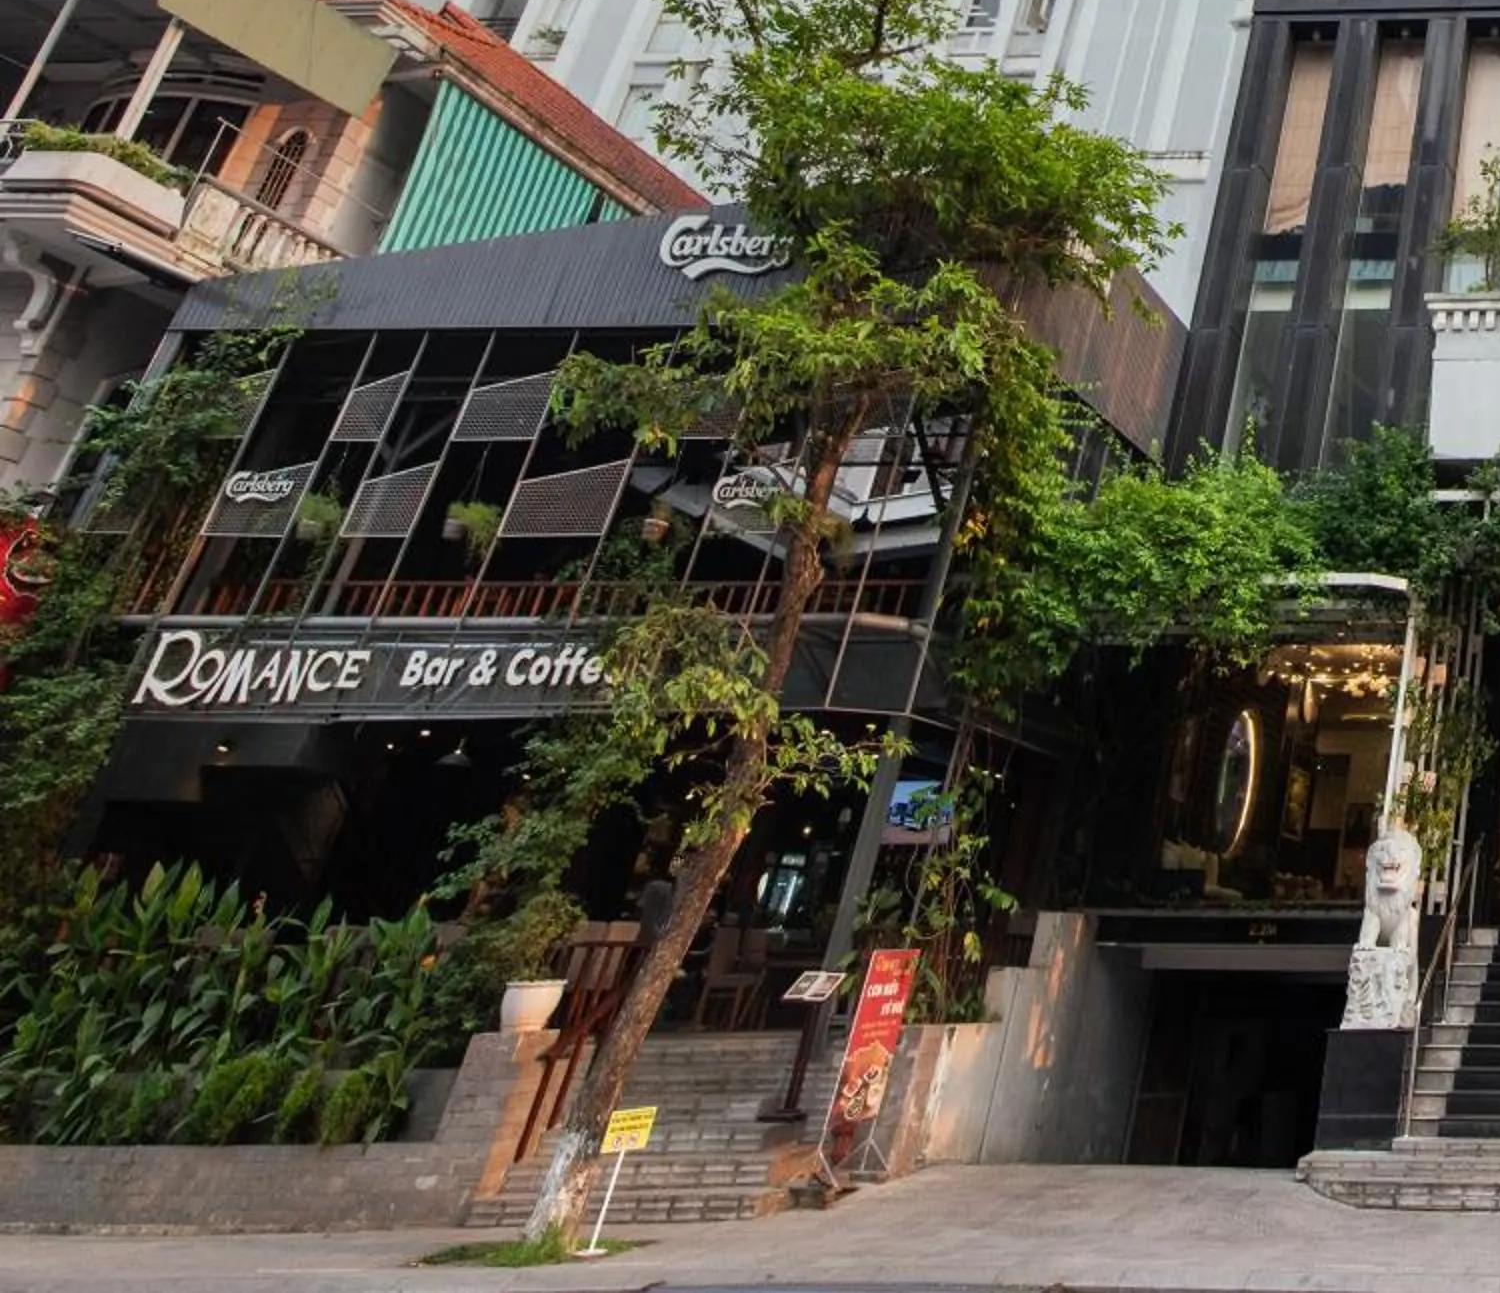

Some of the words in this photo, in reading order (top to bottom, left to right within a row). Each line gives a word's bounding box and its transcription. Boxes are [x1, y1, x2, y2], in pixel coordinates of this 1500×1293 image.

[226, 471, 295, 502] Carlsberg
[132, 630, 370, 705] ROMANCE
[400, 649, 461, 688] Bar
[469, 649, 497, 686] &
